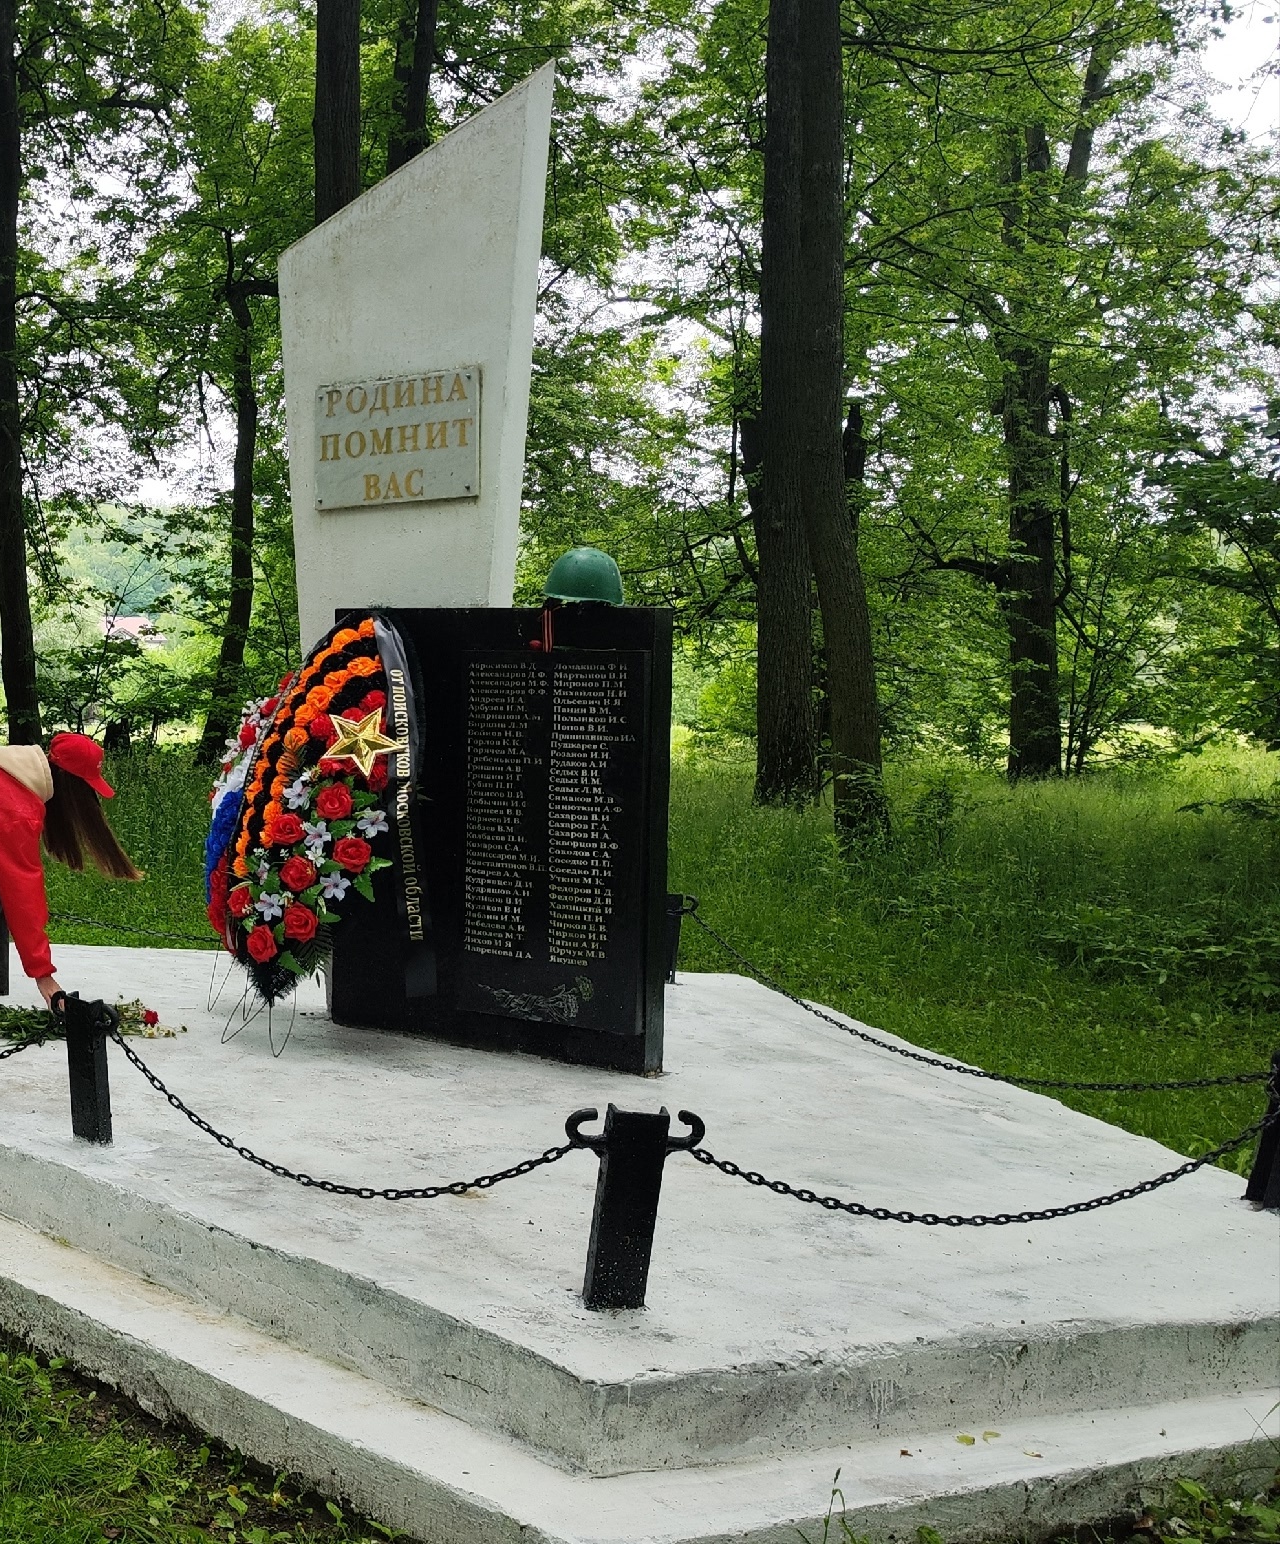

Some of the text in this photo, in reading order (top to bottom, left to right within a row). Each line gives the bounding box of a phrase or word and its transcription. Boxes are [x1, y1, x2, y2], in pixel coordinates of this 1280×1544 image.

[325, 373, 468, 418] РОДИНА
[319, 418, 473, 462] ПОМНИТ
[362, 469, 424, 501] ВАС
[554, 672, 607, 680] Мартынов
[469, 679, 526, 687] Александров
[554, 680, 600, 688] Миронов
[469, 688, 526, 696] Александров
[468, 704, 504, 712] Арбузов
[554, 706, 586, 714] Панин
[554, 723, 585, 731] Попов
[468, 746, 506, 754] Горячев
[550, 741, 598, 750] Пушкарев
[550, 750, 588, 758] Розанов
[468, 755, 520, 764] Гребеньков
[550, 758, 588, 768] Рудаков
[550, 768, 578, 776] Седых
[468, 780, 494, 788] Губин
[549, 776, 578, 784] Седых
[548, 784, 580, 792] Седых
[467, 789, 504, 798] Денисов
[548, 794, 592, 802] Симаков
[390, 669, 404, 684] ОТ
[404, 877, 424, 941] области
[466, 806, 504, 814] Корнеев
[548, 802, 600, 812] Синюткин
[466, 814, 502, 823] Корнеев
[548, 811, 588, 821] Сахаров
[548, 820, 588, 830] Сахаров
[548, 828, 588, 838] Сахаров
[466, 840, 502, 850] Комаров
[549, 838, 598, 848] Скворцов
[466, 849, 516, 860] Комиссаров
[548, 847, 590, 856] Соколов
[466, 858, 527, 870] Константинов
[548, 866, 590, 875] Соседко
[466, 875, 512, 886] Кудрявцев
[549, 874, 580, 884] Уткин
[466, 884, 511, 894] Кудряшов
[548, 884, 592, 894] Федоров
[466, 893, 503, 904] Куликов
[548, 892, 592, 904] Федоров
[550, 920, 586, 930] Чирков
[548, 928, 586, 938] Чирков
[549, 946, 583, 957] Юрчук
[549, 956, 588, 966] Якушев
